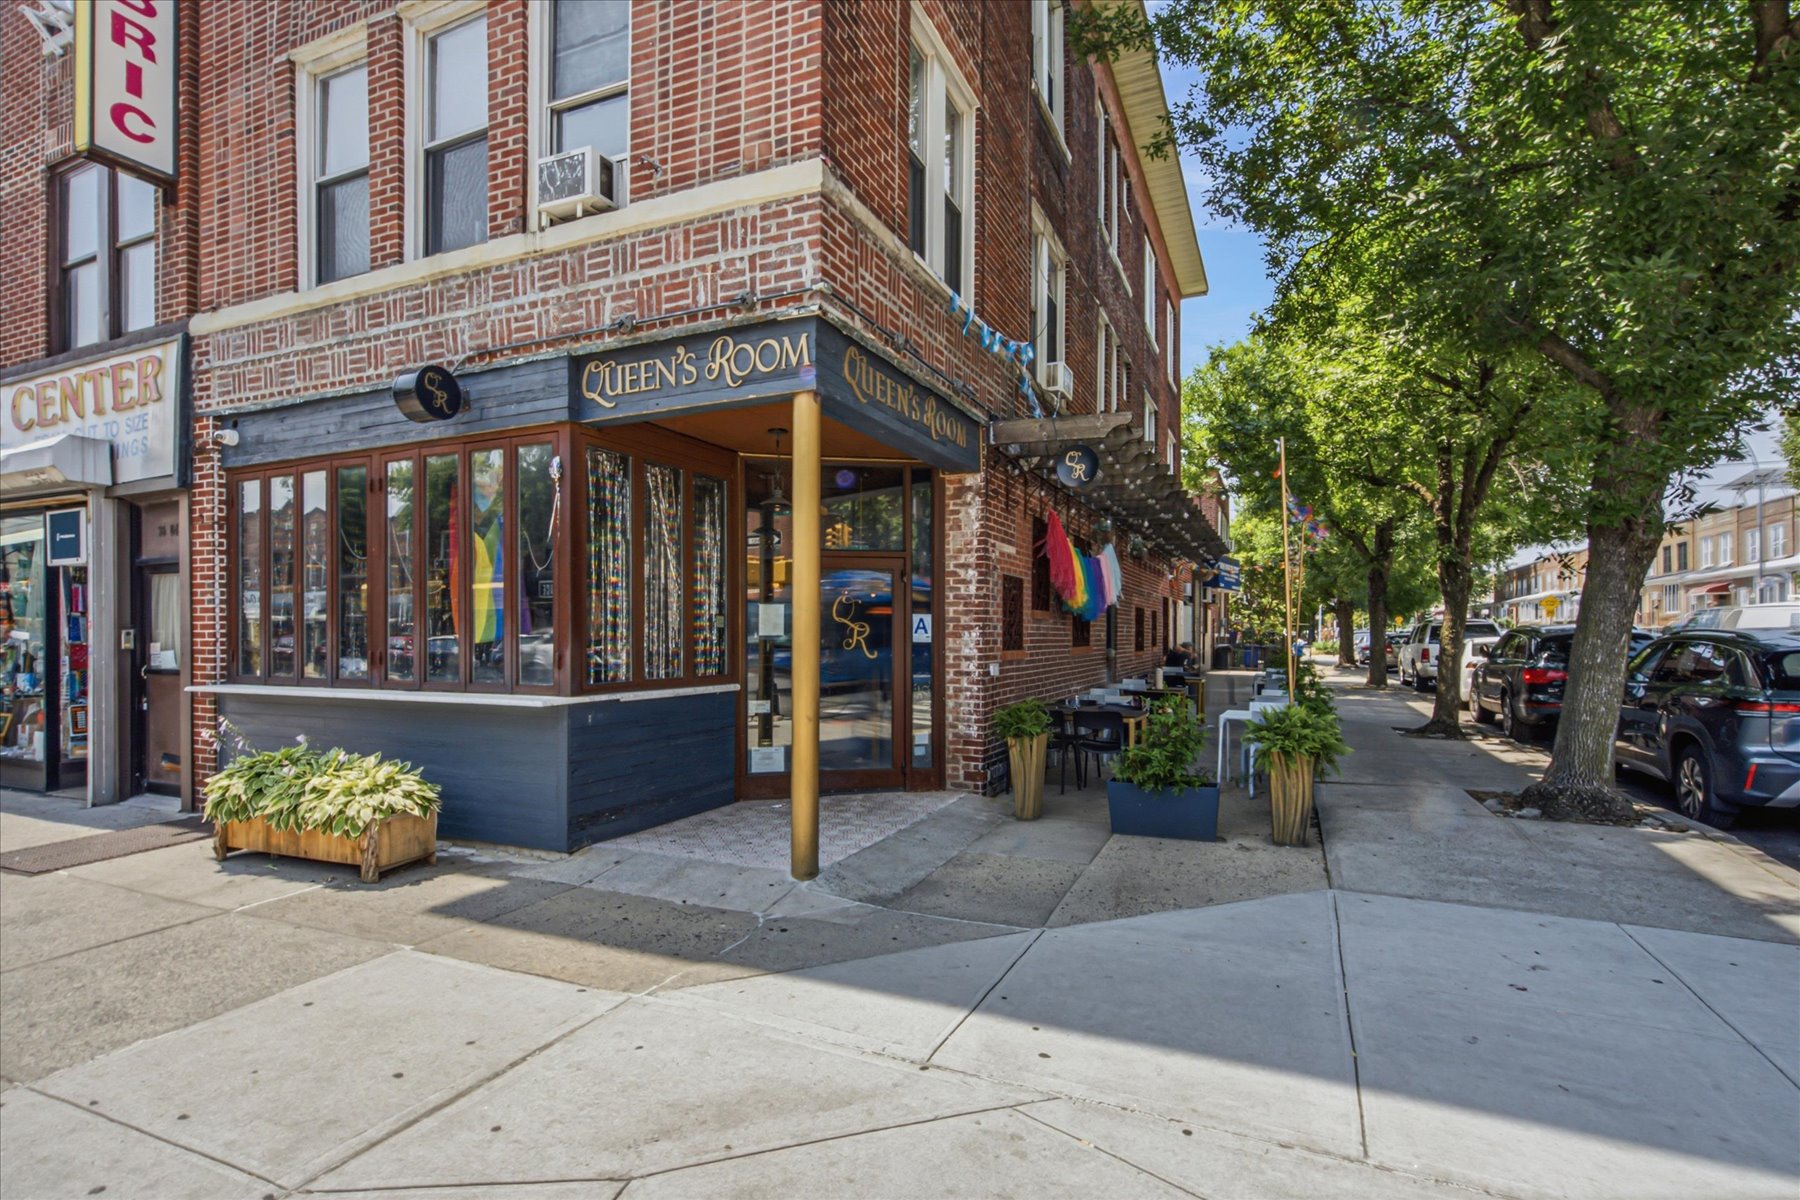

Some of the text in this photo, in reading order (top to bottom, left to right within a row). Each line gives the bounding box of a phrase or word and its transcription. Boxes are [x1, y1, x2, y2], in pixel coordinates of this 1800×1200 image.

[11, 355, 162, 432] CENTER
[581, 333, 810, 409] QUEEN'S ROOM
[844, 345, 967, 449] QUEEN'S ROOM
[104, 421, 119, 438] TO
[125, 412, 149, 435] SIZE
[914, 617, 929, 634] A
